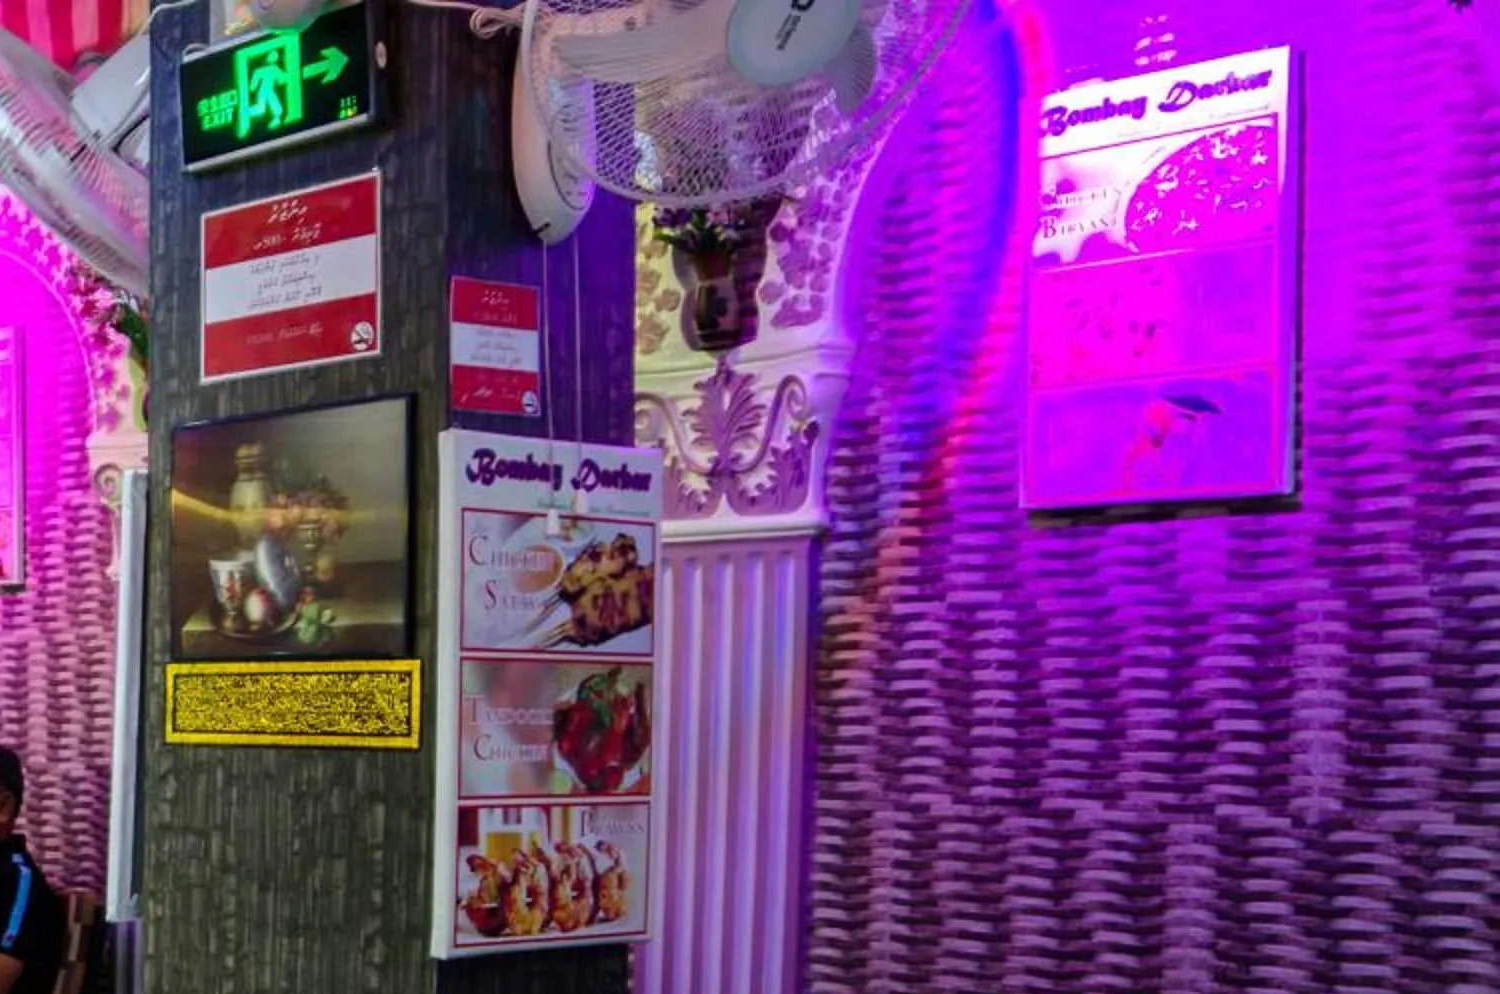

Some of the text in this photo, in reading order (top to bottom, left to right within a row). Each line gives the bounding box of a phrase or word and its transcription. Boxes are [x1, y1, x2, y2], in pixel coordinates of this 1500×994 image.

[203, 107, 234, 129] EXIT
[1040, 69, 1273, 137] Bombay Darbar
[466, 448, 652, 492] Bombay Darbar
